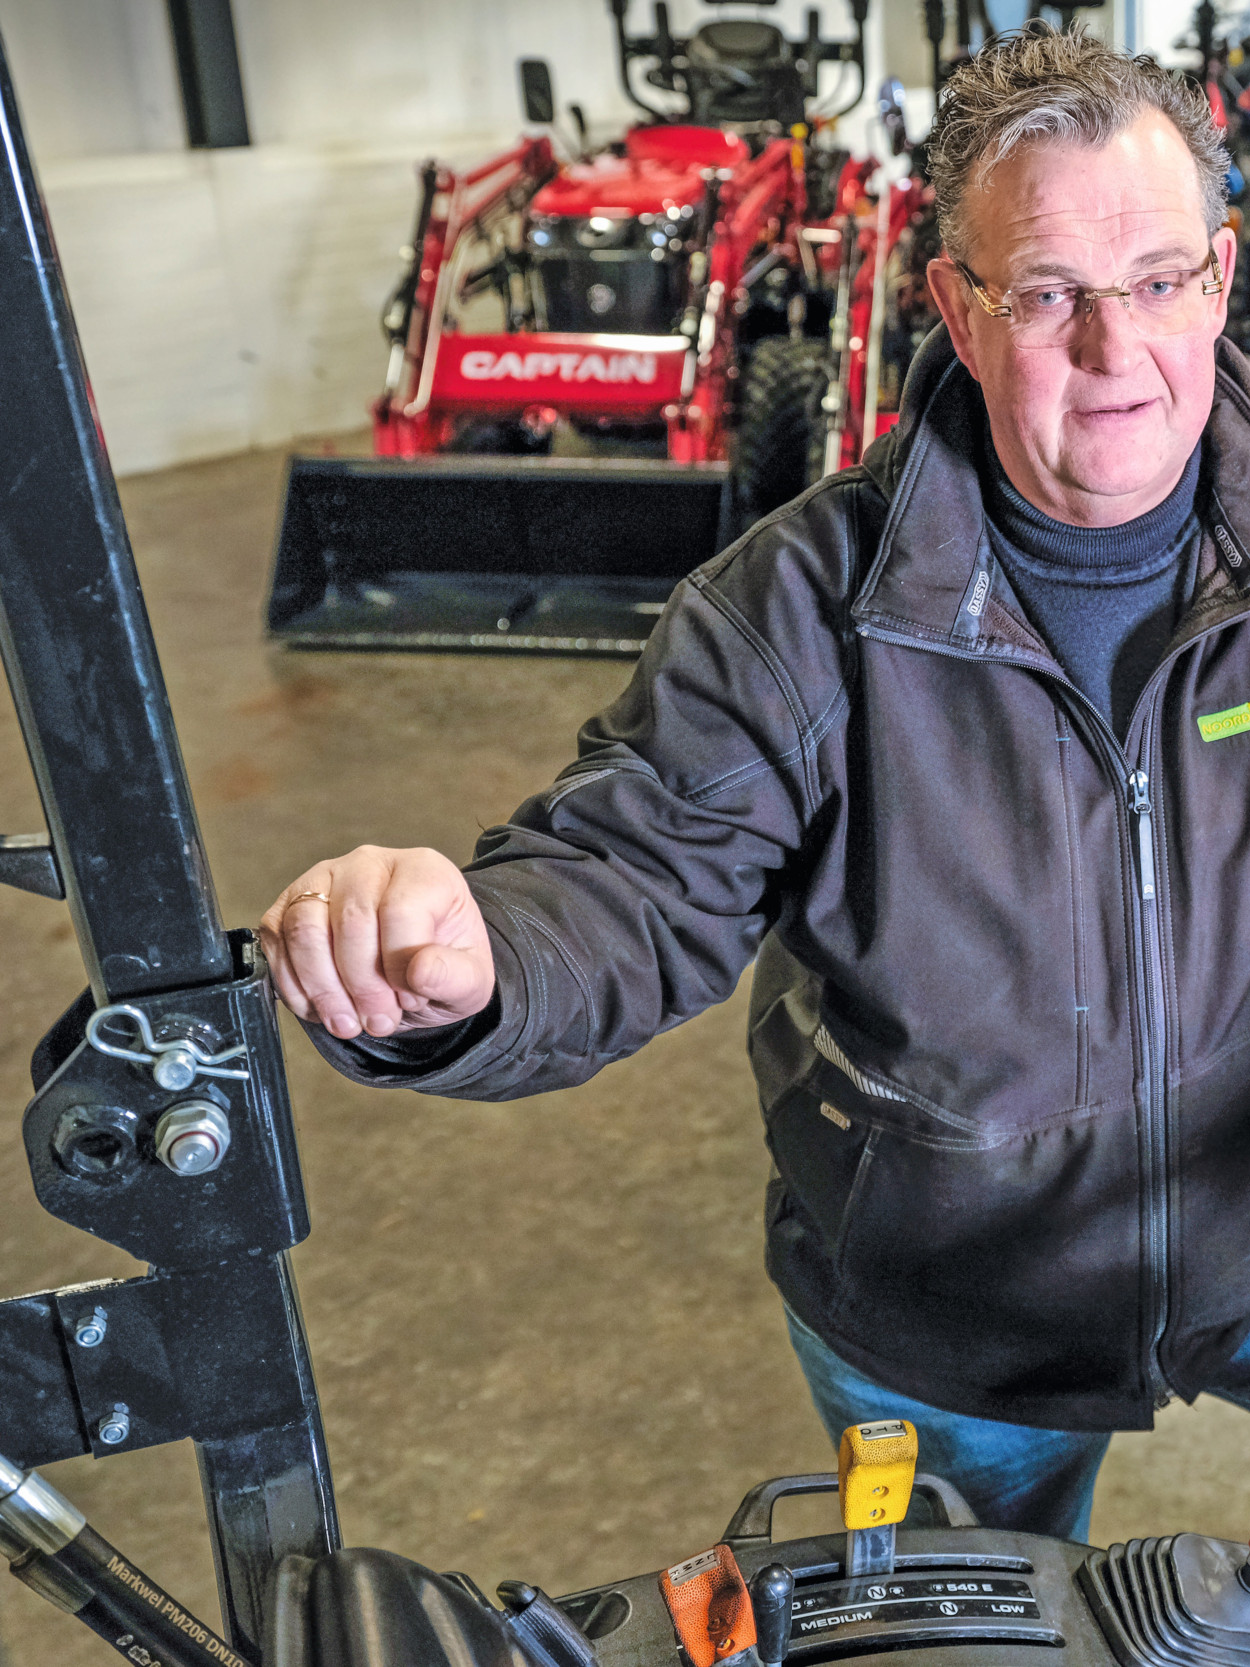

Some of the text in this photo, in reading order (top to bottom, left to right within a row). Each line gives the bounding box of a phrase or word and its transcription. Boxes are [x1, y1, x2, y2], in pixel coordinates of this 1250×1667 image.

[461, 351, 657, 384] CAPTAIN
[968, 576, 987, 614] DASSY
[1202, 713, 1250, 735] NOORD
[106, 1555, 165, 1609] Markwel
[161, 1601, 209, 1645] PM206
[869, 1583, 993, 1599] N 540 E
[801, 1602, 1024, 1631] MEDIUM N LOW
